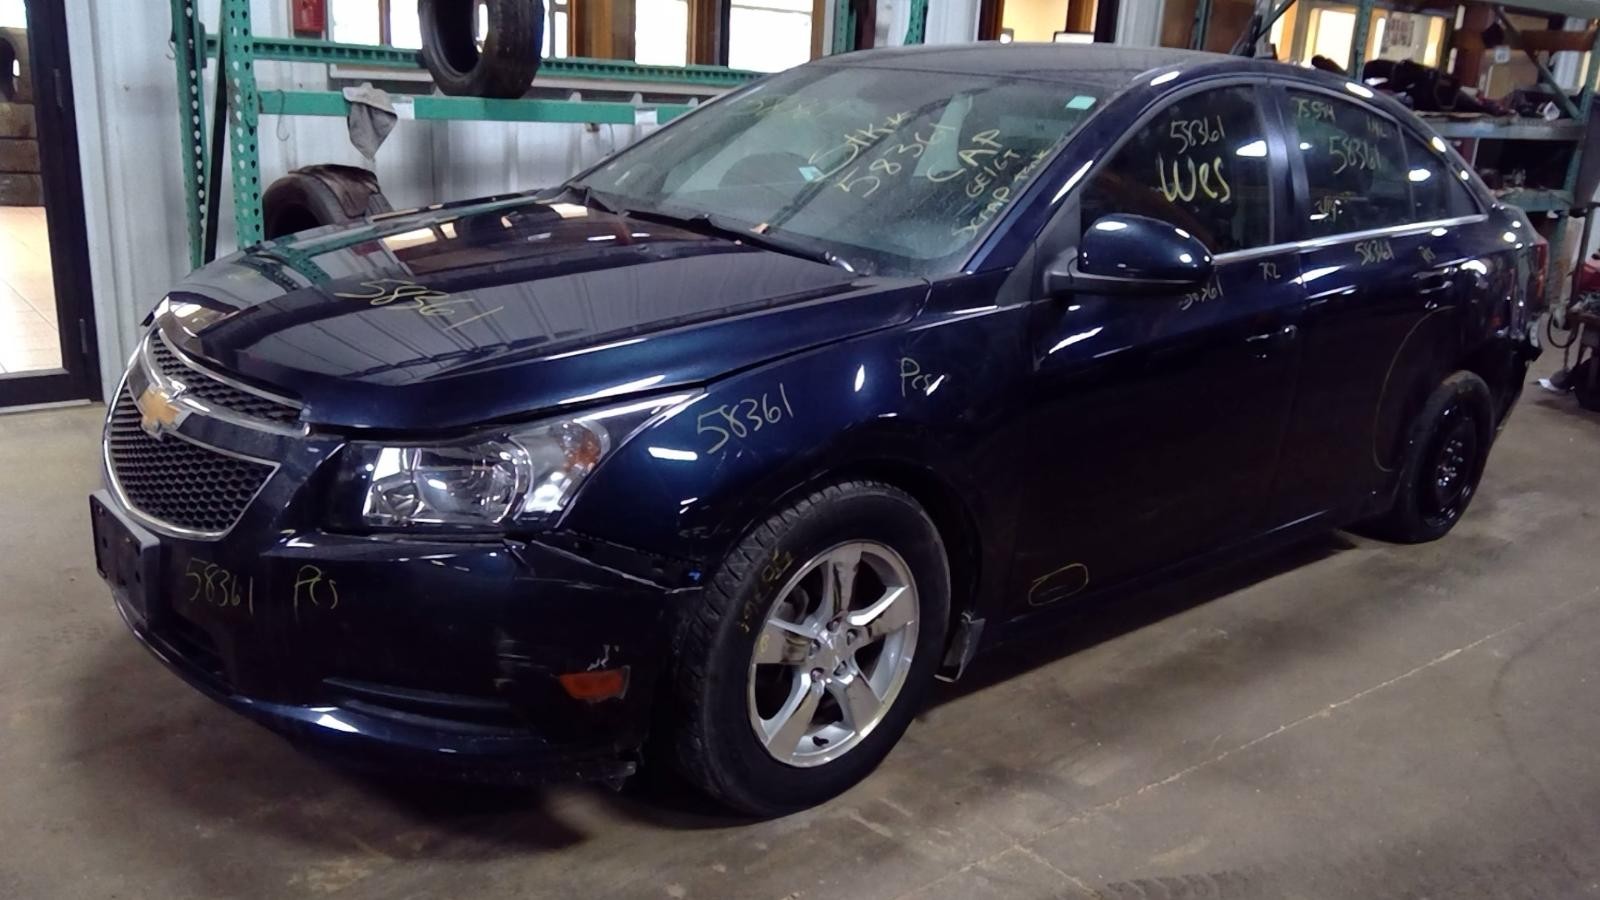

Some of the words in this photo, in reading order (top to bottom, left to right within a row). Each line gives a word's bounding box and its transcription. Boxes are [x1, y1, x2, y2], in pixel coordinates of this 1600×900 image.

[836, 121, 956, 198] 58361
[1169, 114, 1226, 154] 58361
[333, 278, 505, 332] 58361
[697, 382, 794, 454] 58361
[186, 556, 254, 616] 58361
